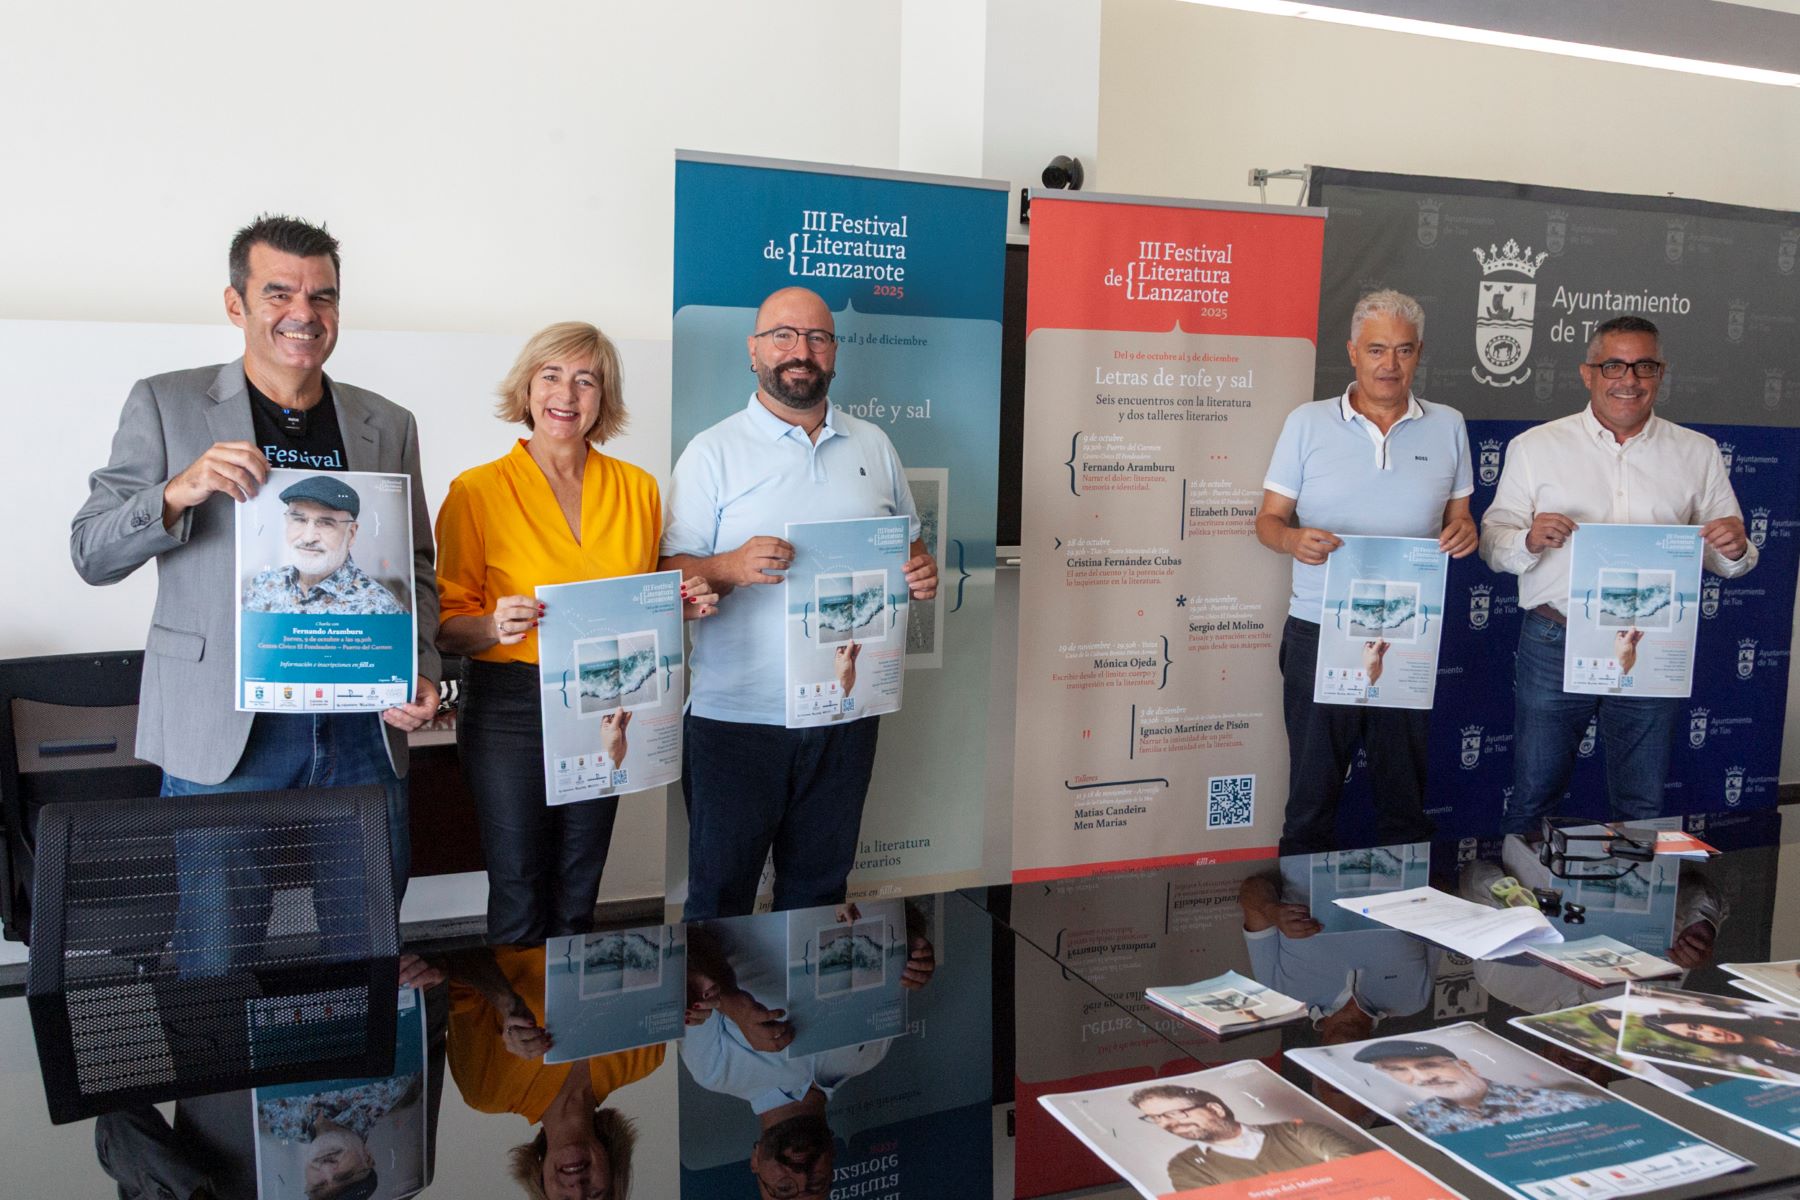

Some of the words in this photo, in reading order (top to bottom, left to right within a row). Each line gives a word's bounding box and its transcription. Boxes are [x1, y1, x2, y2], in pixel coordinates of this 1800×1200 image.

[802, 211, 826, 231] III
[830, 213, 907, 237] Festival
[764, 240, 783, 259] de
[802, 234, 906, 259] Literatura
[1139, 242, 1160, 259] III
[1164, 244, 1232, 264] Festival
[802, 256, 904, 281] Lanzarote
[1104, 268, 1122, 286] de
[1139, 263, 1230, 284] Literatura
[874, 285, 903, 298] 2025
[1137, 284, 1228, 304] Lanzarote
[1551, 286, 1690, 314] Ayuntamiento
[1201, 308, 1227, 319] 2025
[1551, 320, 1574, 341] de
[848, 334, 856, 343] al
[866, 334, 877, 344] de
[879, 334, 927, 346] diciembre
[1114, 351, 1128, 359] Del
[1202, 354, 1239, 362] diciembre
[1096, 368, 1147, 385] Letras
[1153, 368, 1174, 386] de
[1179, 369, 1212, 387] rofe
[1215, 375, 1226, 392] y
[1230, 370, 1252, 388] sal
[1096, 394, 1115, 404] Seis
[1118, 396, 1174, 406] encuentros
[1196, 396, 1204, 406] la
[1207, 397, 1251, 407] literatura
[848, 398, 884, 418] rofe
[890, 405, 902, 423] y
[907, 400, 930, 419] sal
[1118, 413, 1125, 422] y
[1127, 410, 1144, 420] dos
[1147, 410, 1183, 420] talleres
[1186, 411, 1228, 421] literarios
[263, 445, 343, 468] Festival
[1736, 455, 1778, 465] Ayuntamiento
[1083, 462, 1124, 471] Fernando
[1127, 462, 1175, 471] Aramburu
[1190, 507, 1228, 516] Elizabeth
[1232, 507, 1256, 516] Duval
[1067, 558, 1101, 568] Cristina
[1104, 557, 1152, 567] Fernández
[1154, 556, 1181, 566] Cubas
[1724, 587, 1765, 597] Ayuntamiento
[1495, 596, 1518, 605] Ayunta
[1189, 623, 1215, 633] Sergio
[1217, 621, 1230, 631] del
[1232, 620, 1264, 630] Molino
[1094, 659, 1128, 669] Mónica
[1130, 658, 1156, 669] Ojeda
[1712, 716, 1752, 726] Ayuntamiento
[1140, 726, 1172, 738] Ignacio
[1175, 723, 1212, 734] Martínez
[1215, 722, 1224, 731] de
[1226, 720, 1249, 730] Pisón
[1106, 805, 1146, 815] Candeira
[1074, 822, 1093, 830] Men
[860, 842, 870, 853] la
[875, 838, 930, 852] literatura
